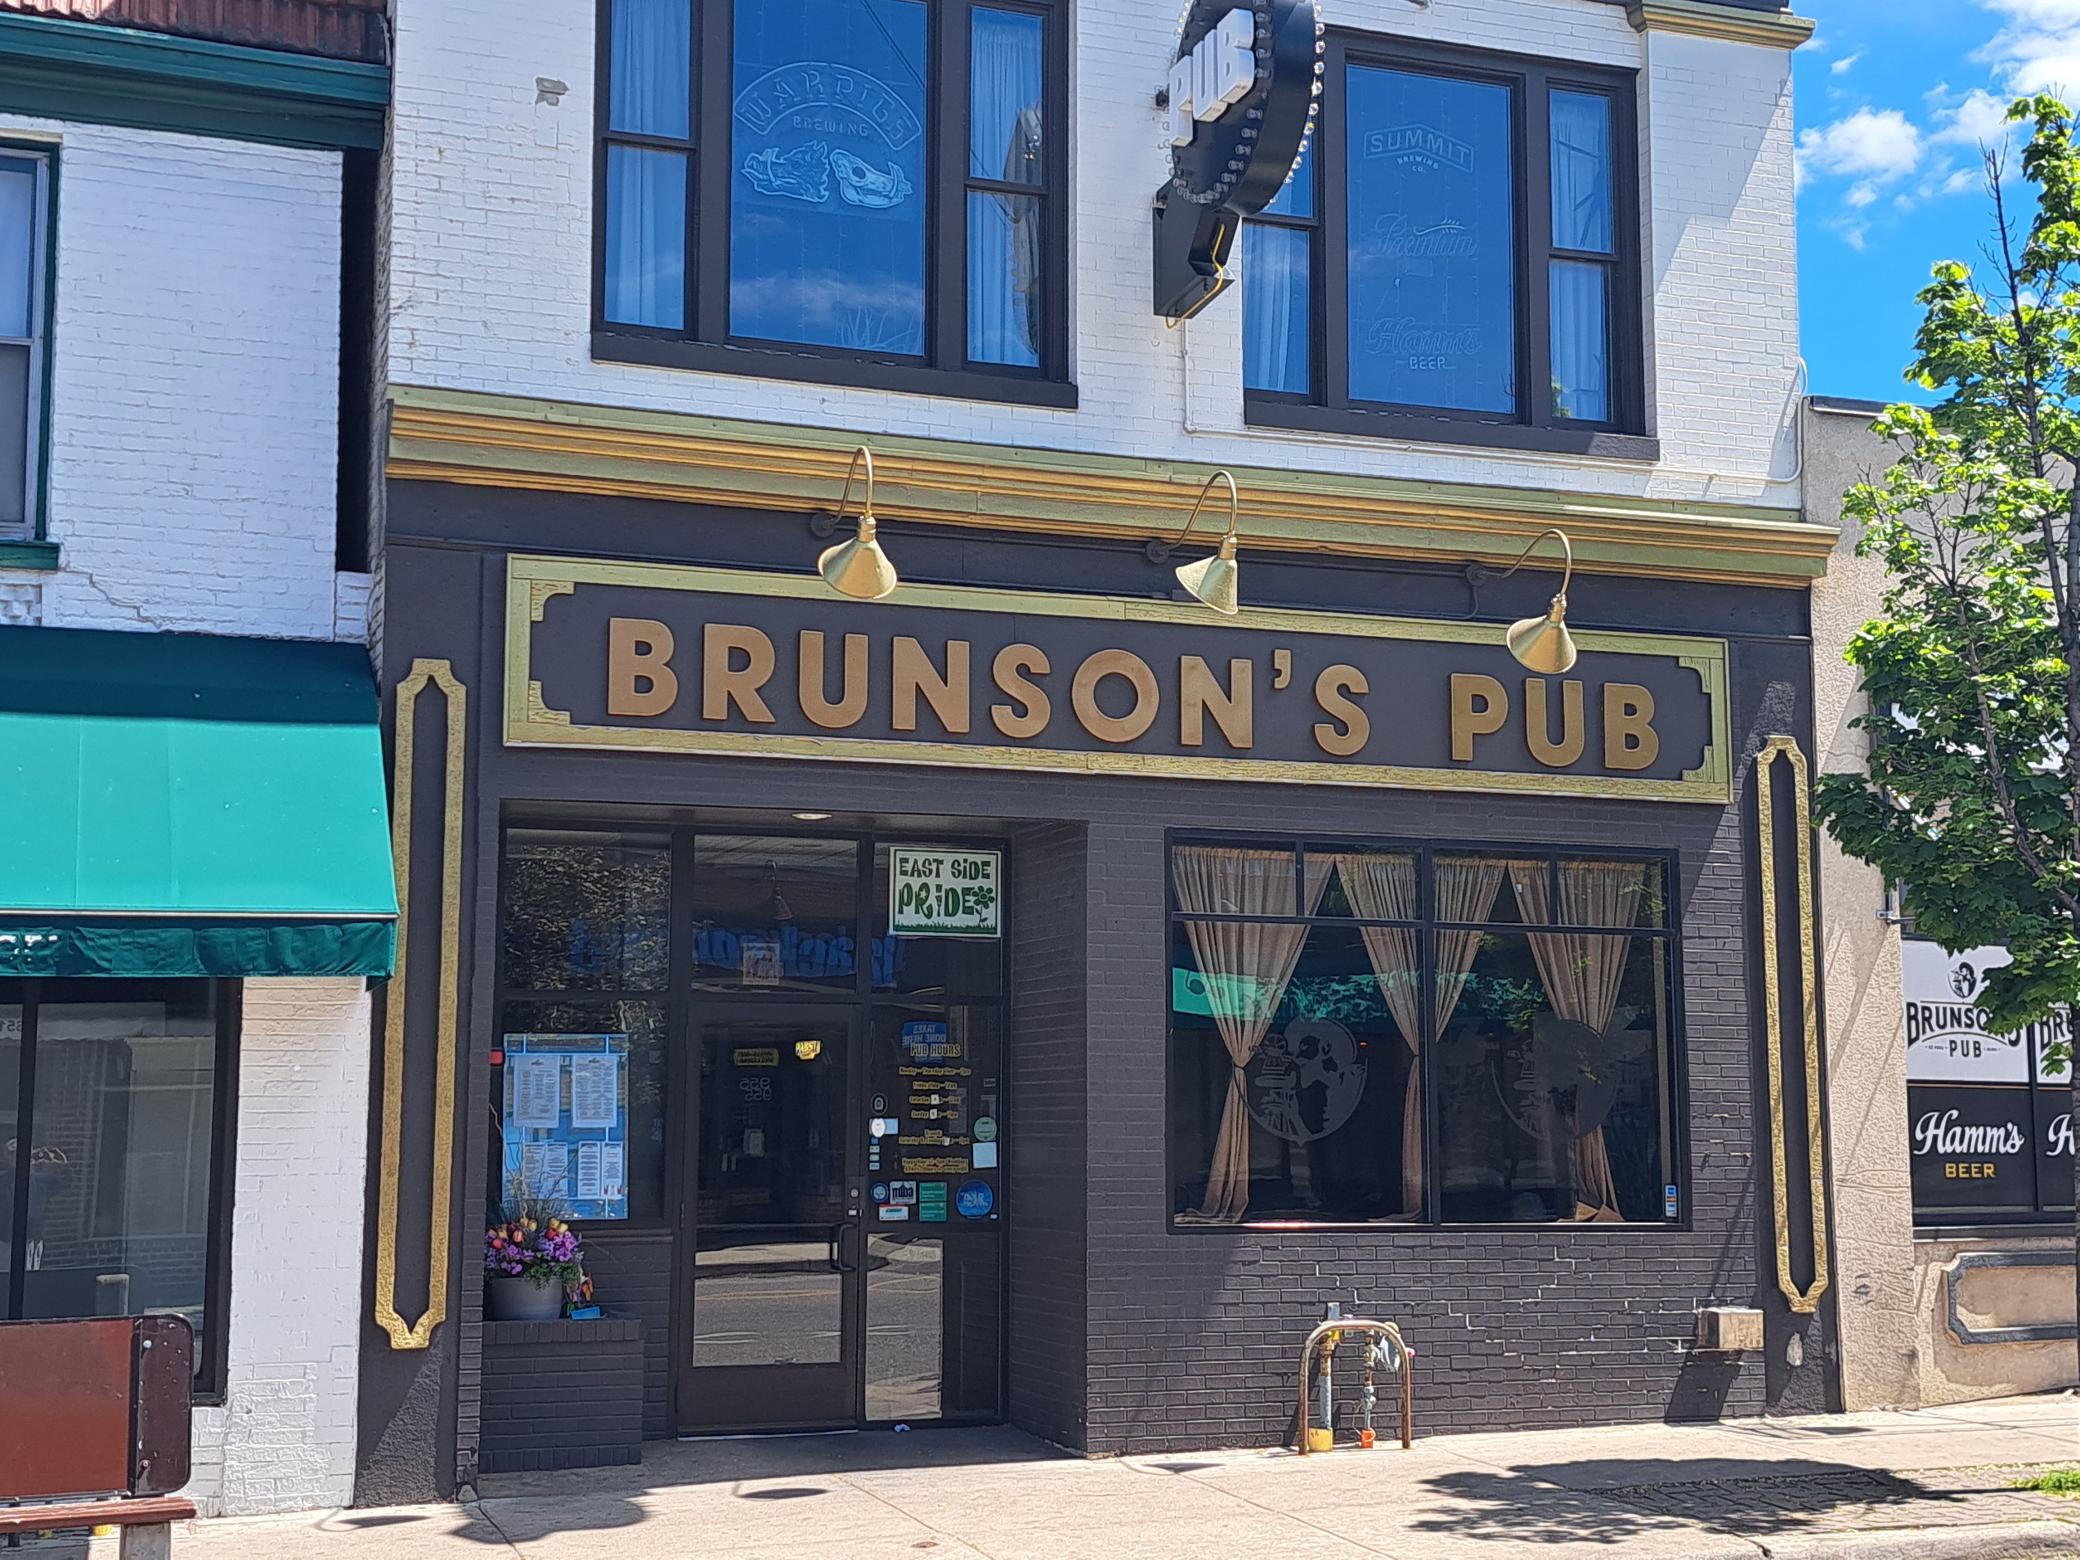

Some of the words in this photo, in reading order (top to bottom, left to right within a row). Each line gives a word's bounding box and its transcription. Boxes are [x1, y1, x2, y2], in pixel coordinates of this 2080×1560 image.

[1169, 8, 1255, 147] PUB
[740, 70, 912, 140] WARPIGS
[793, 115, 869, 136] BREWING
[1370, 129, 1469, 164] SUMMIT
[1409, 356, 1446, 369] BEER
[607, 617, 1370, 757] BRUNSON'S
[1450, 672, 1659, 770] PUB
[899, 857, 944, 878] EAST
[910, 1043, 928, 1057] PUB
[930, 1043, 960, 1057] HOURS
[1949, 1039, 1982, 1058] PUB
[1912, 1109, 2025, 1156] Hamm's
[1944, 1162, 1997, 1179] BEER
